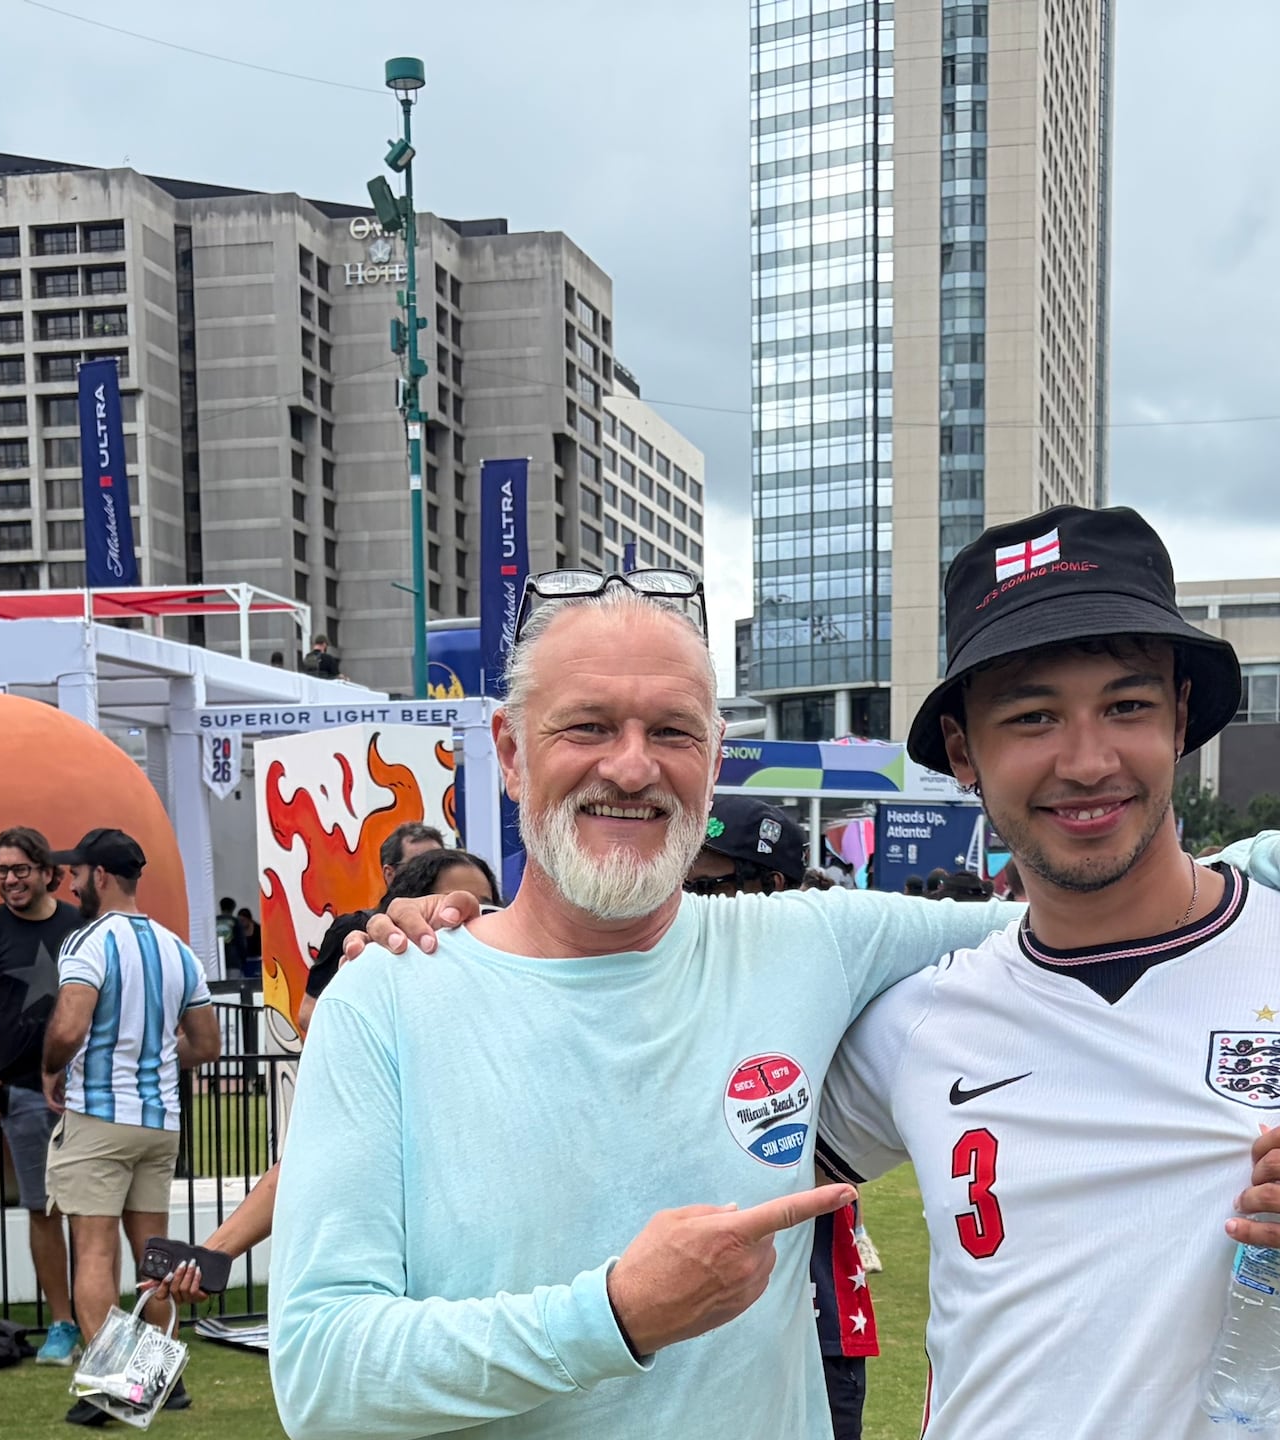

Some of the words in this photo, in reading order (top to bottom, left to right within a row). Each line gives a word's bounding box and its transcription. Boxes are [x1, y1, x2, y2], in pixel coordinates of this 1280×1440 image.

[344, 262, 408, 286] HOTE
[95, 383, 111, 468] ULTRA
[500, 480, 516, 558] ULTRA
[102, 492, 123, 577] Michelob
[1000, 567, 1047, 593] COMING
[1051, 560, 1090, 573] HOME
[200, 711, 311, 728] SUPERIOR
[323, 709, 391, 723] LIGHT
[401, 708, 459, 723] BEER
[212, 737, 231, 760] 20
[212, 760, 232, 783] 26
[886, 810, 925, 823] Heads
[926, 811, 947, 827] Up,
[886, 825, 932, 839] Atlanta!
[734, 1079, 756, 1092] SINCE
[736, 1102, 770, 1125] Miami
[761, 1141, 779, 1158] SUN
[951, 1127, 1005, 1260] 3
